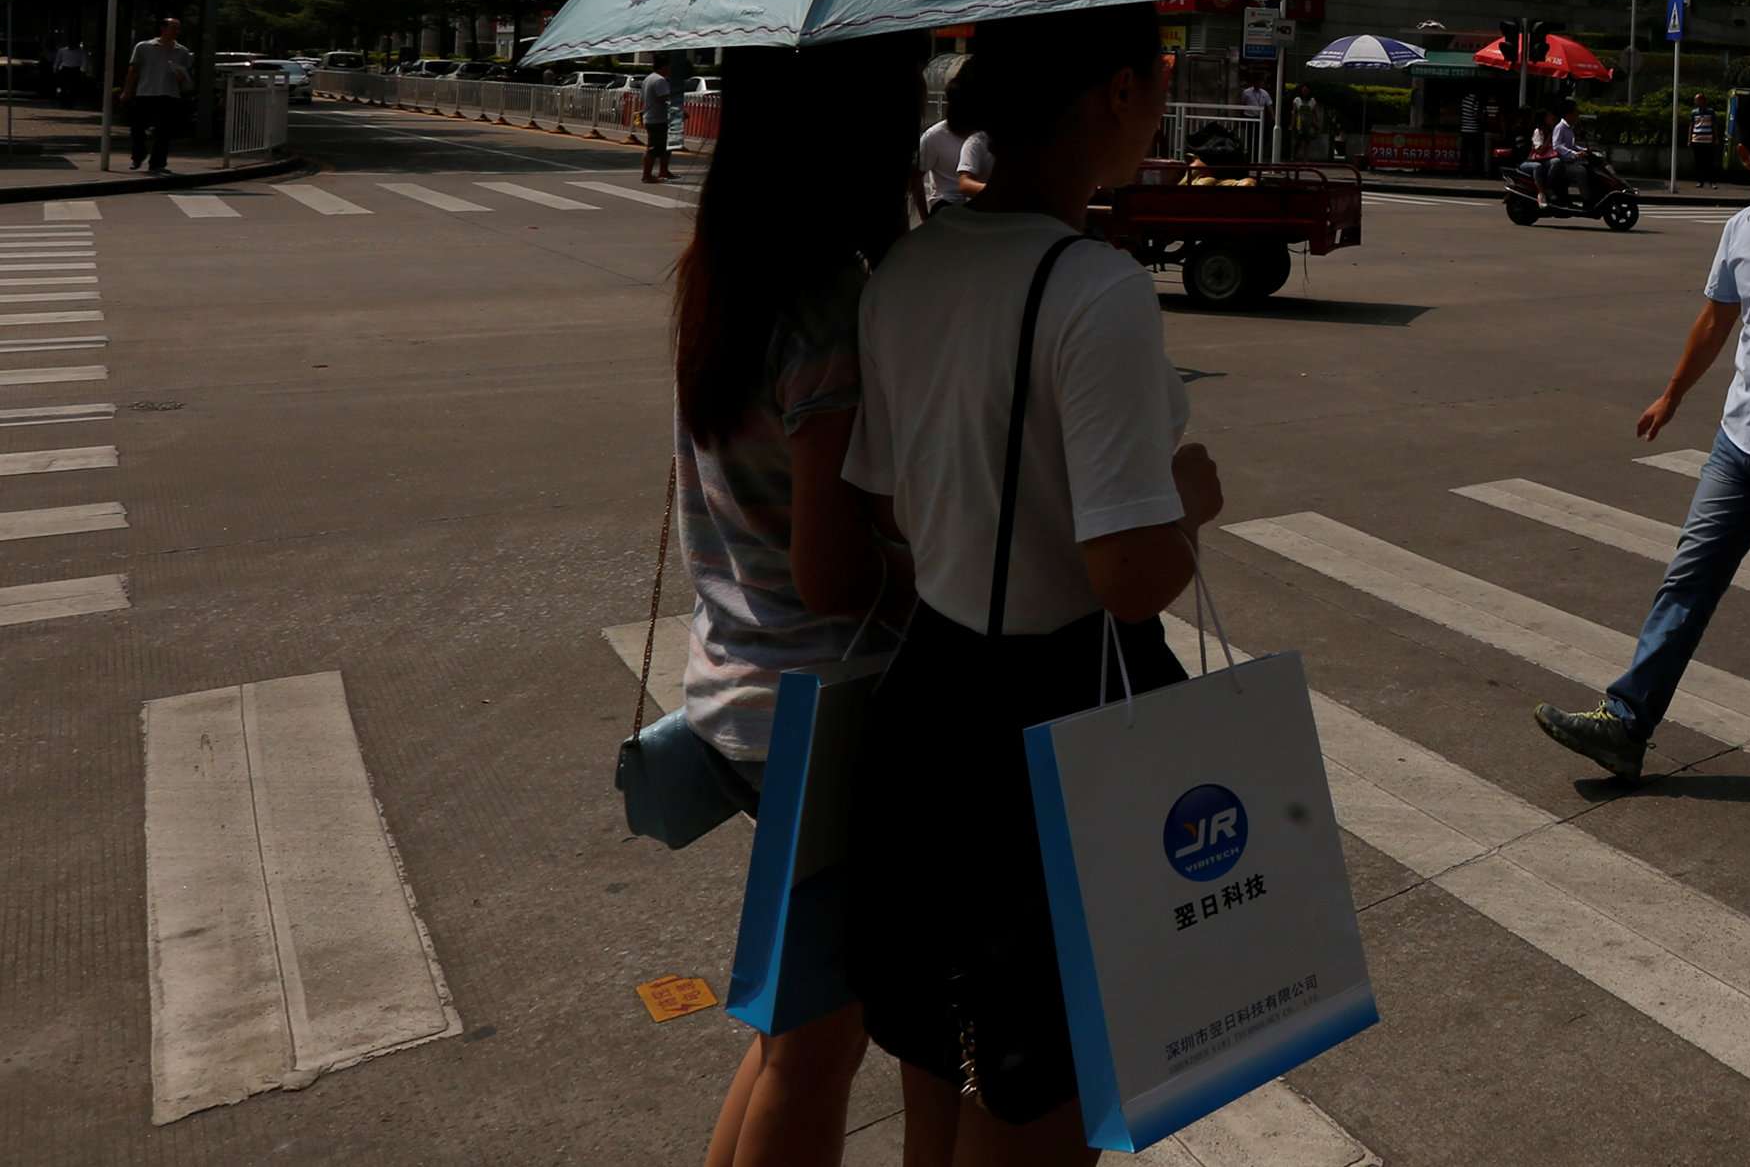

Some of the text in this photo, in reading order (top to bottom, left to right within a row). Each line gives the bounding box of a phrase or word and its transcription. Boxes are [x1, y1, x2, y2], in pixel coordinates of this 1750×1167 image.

[1174, 873, 1267, 931] 翌日科技
[1165, 974, 1319, 1061] 深圳市翌日科技有限公司
